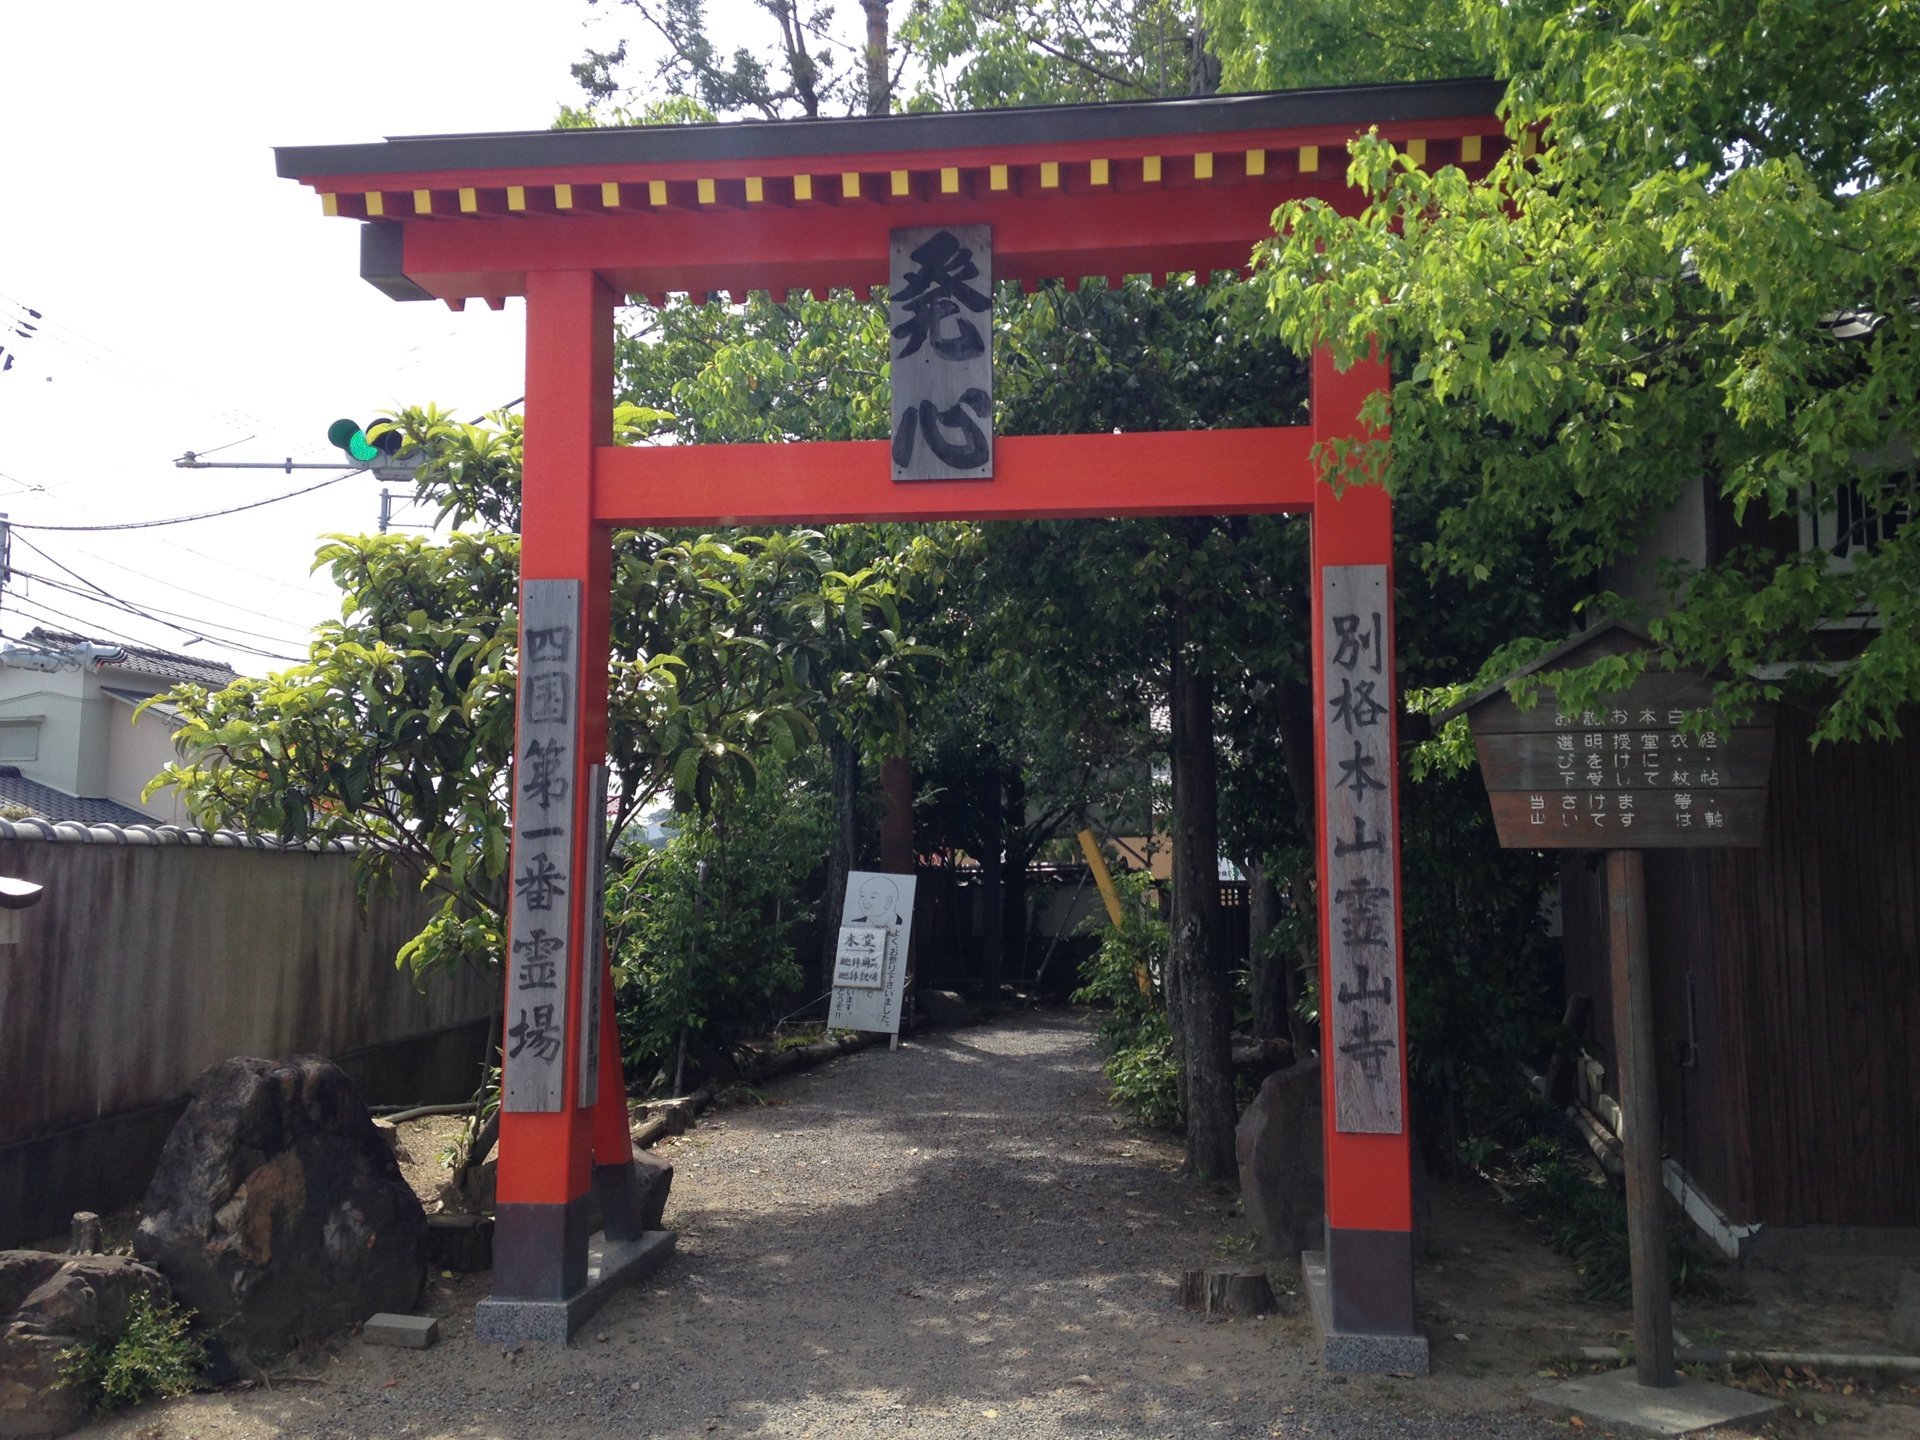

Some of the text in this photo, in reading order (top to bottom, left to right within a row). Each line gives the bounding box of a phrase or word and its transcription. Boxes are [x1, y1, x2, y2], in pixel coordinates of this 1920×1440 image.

[509, 626, 571, 1062] 四国第一番霊場
[1329, 611, 1397, 1084] 別格本山霊山寺
[1530, 794, 1545, 825] 当山
[1639, 708, 1660, 786] 本堂にて
